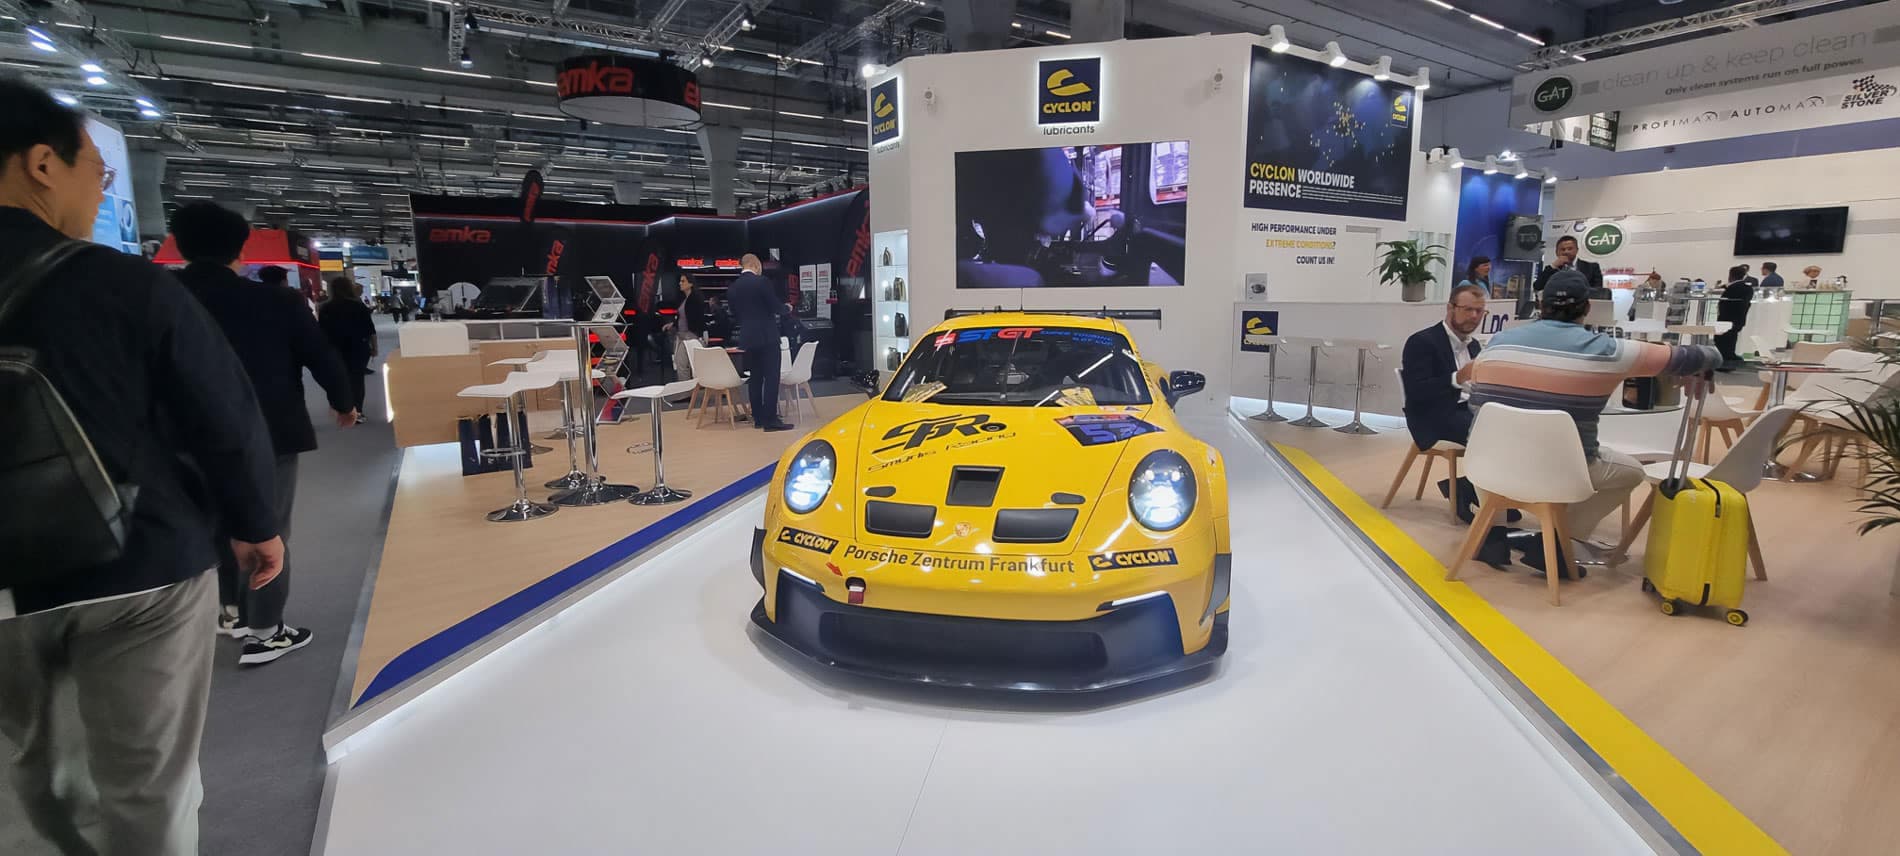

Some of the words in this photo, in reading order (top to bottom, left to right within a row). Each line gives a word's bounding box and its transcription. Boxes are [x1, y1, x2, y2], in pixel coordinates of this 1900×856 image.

[1602, 69, 1659, 90] clean
[1666, 63, 1696, 81] up
[1702, 54, 1719, 73] &
[1725, 46, 1785, 69] keep
[1792, 31, 1867, 58] clean
[1664, 85, 1688, 96] Only
[1689, 81, 1716, 91] clean
[1719, 74, 1760, 87] systems
[1762, 71, 1781, 80] run
[1784, 67, 1799, 76] on
[1802, 63, 1821, 73] full
[1537, 86, 1569, 103] GAT
[1841, 97, 1885, 109] STONE
[1844, 89, 1890, 102] SILVER
[1043, 101, 1092, 114] CYCLON
[1730, 99, 1820, 119] AUTOMAX
[1043, 125, 1095, 136] lubricants
[1632, 112, 1716, 132] PROFIMAX
[1250, 162, 1296, 181] CYCLON
[1297, 168, 1355, 189] WORLDWIDE
[1249, 179, 1302, 198] PRESENCE
[429, 226, 492, 243] emka
[1251, 222, 1269, 232] HIGH
[1269, 223, 1316, 235] PERFORMANCE
[1317, 226, 1336, 236] UNDER
[1265, 239, 1296, 249] EXTREME
[1587, 232, 1621, 247] GAT
[1296, 255, 1318, 265] COUNT
[1318, 255, 1327, 265] US
[794, 531, 833, 551] CYCLON
[844, 544, 908, 565] Porsche
[911, 551, 985, 571] Zentrum
[989, 556, 1075, 573] Frankfurt
[1115, 549, 1171, 566] CYCLON
